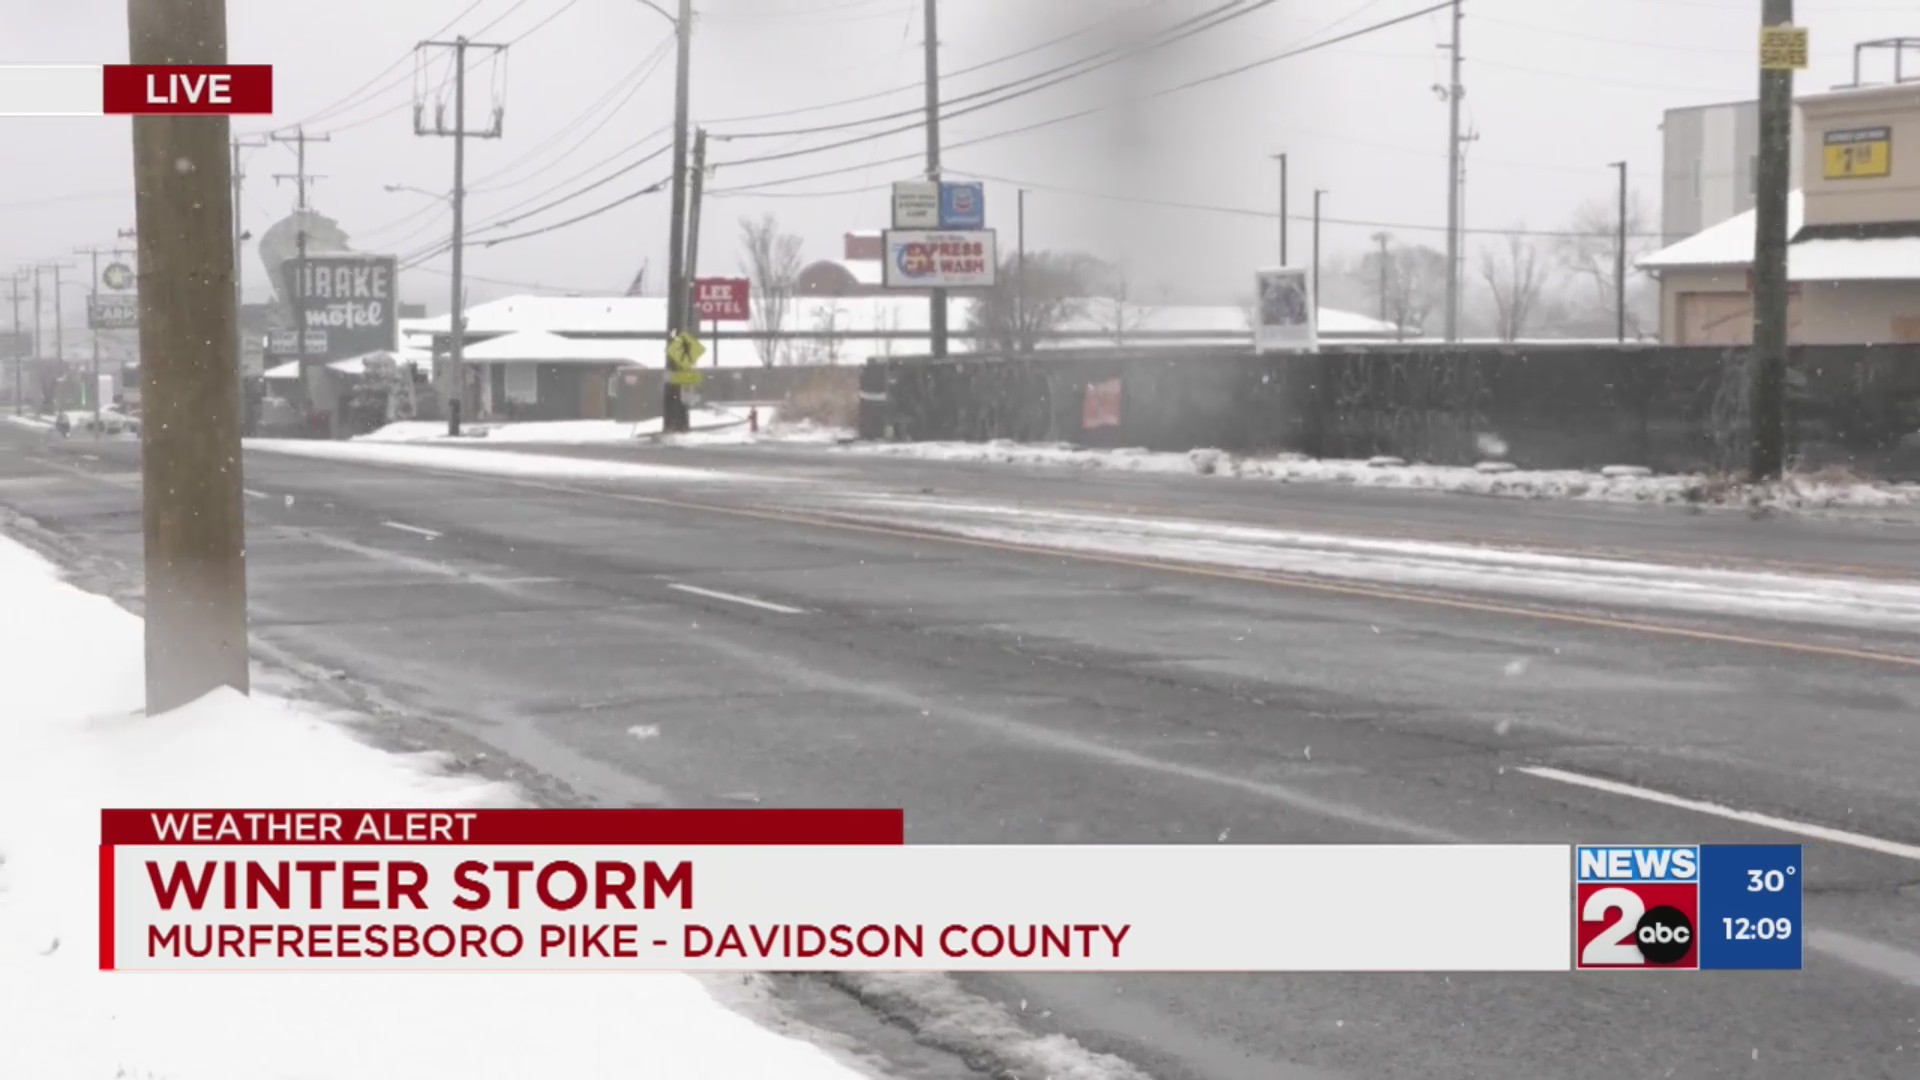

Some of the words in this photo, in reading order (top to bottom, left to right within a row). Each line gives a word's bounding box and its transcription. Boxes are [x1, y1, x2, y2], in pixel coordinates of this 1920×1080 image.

[905, 241, 983, 257] EXPRESS
[905, 259, 936, 273] CAR
[940, 259, 985, 273] WASH
[699, 284, 733, 300] LEE
[304, 301, 384, 330] motel
[693, 301, 742, 314] OTEL
